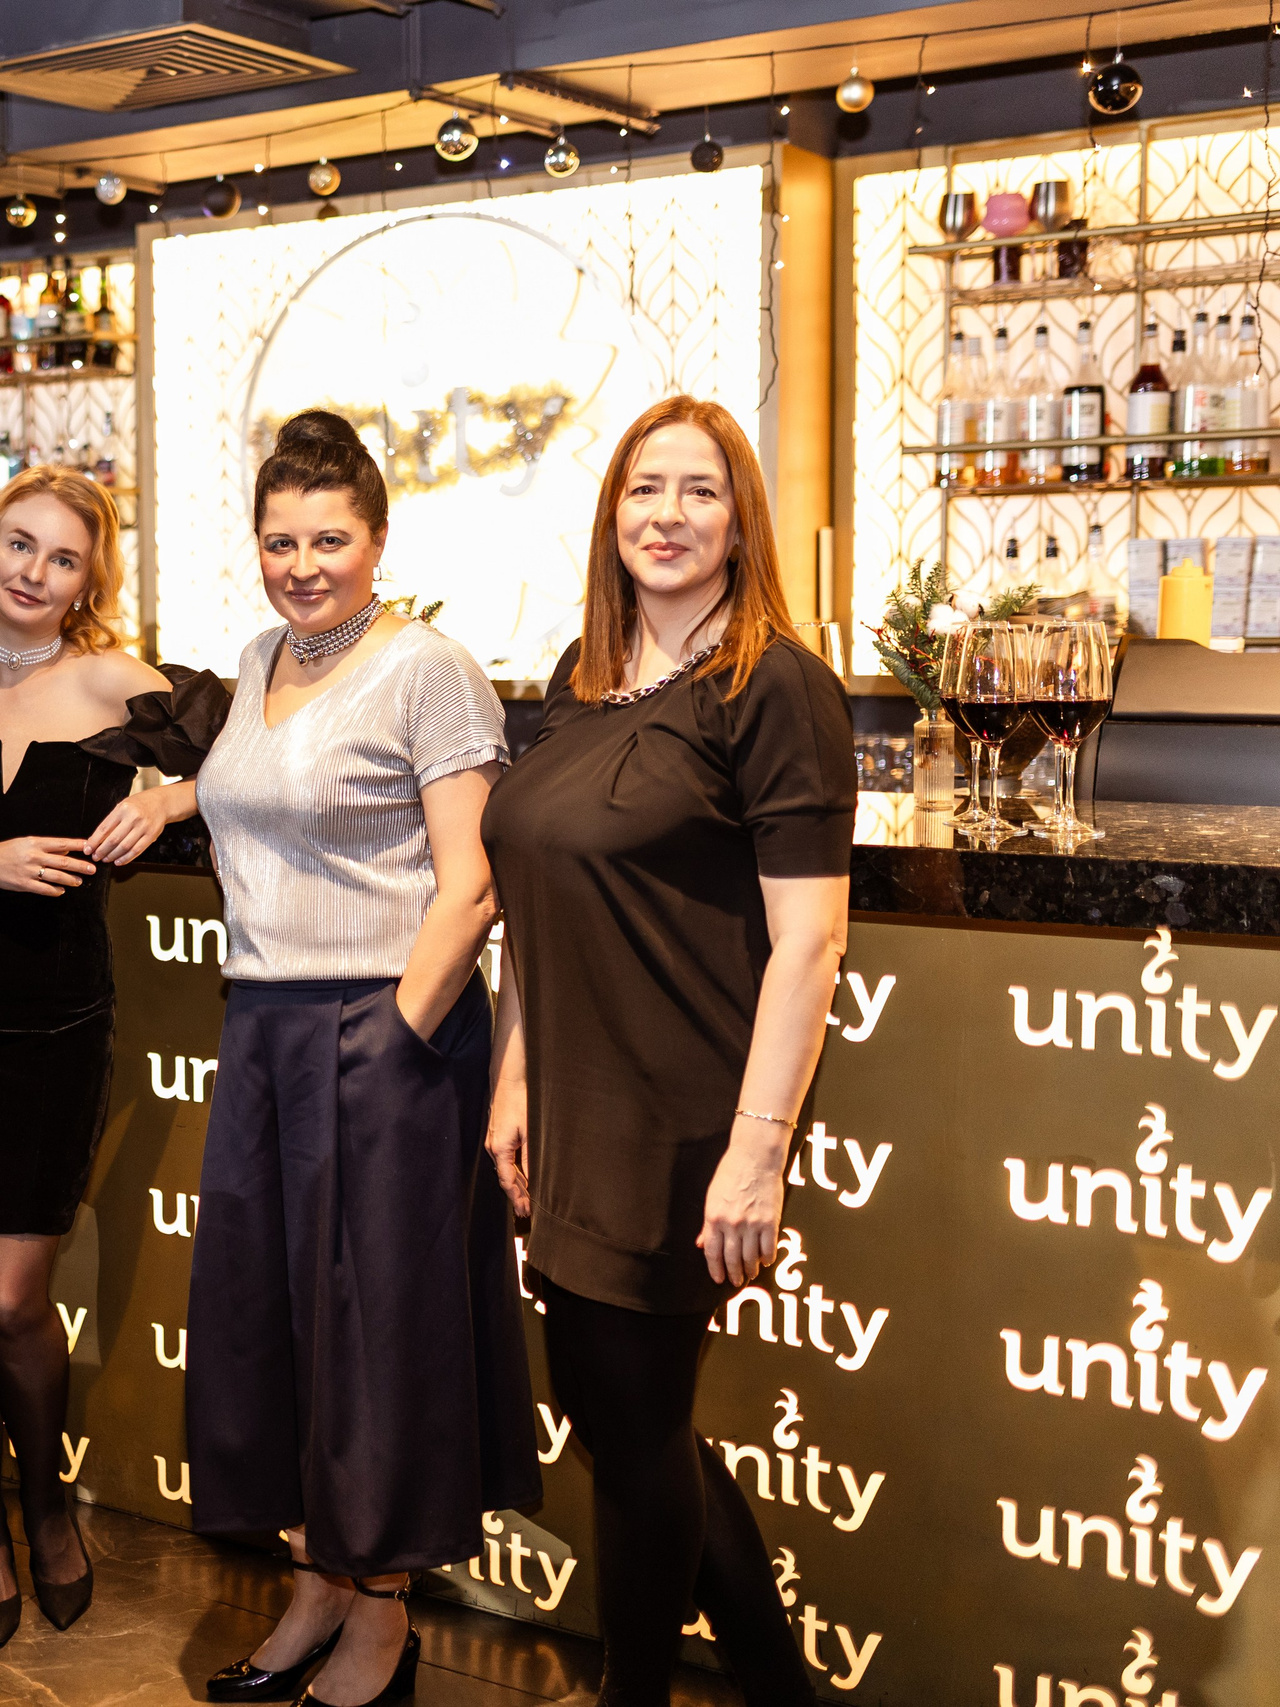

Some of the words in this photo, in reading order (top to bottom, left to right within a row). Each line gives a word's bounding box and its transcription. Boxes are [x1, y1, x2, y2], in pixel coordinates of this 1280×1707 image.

[1007, 926, 1278, 1081] unity
[1002, 1103, 1274, 1264] unity
[708, 1227, 890, 1371] nity
[999, 1278, 1269, 1443] unity
[706, 1387, 887, 1532] nity
[995, 1453, 1263, 1616] unity
[441, 1510, 578, 1611] ity
